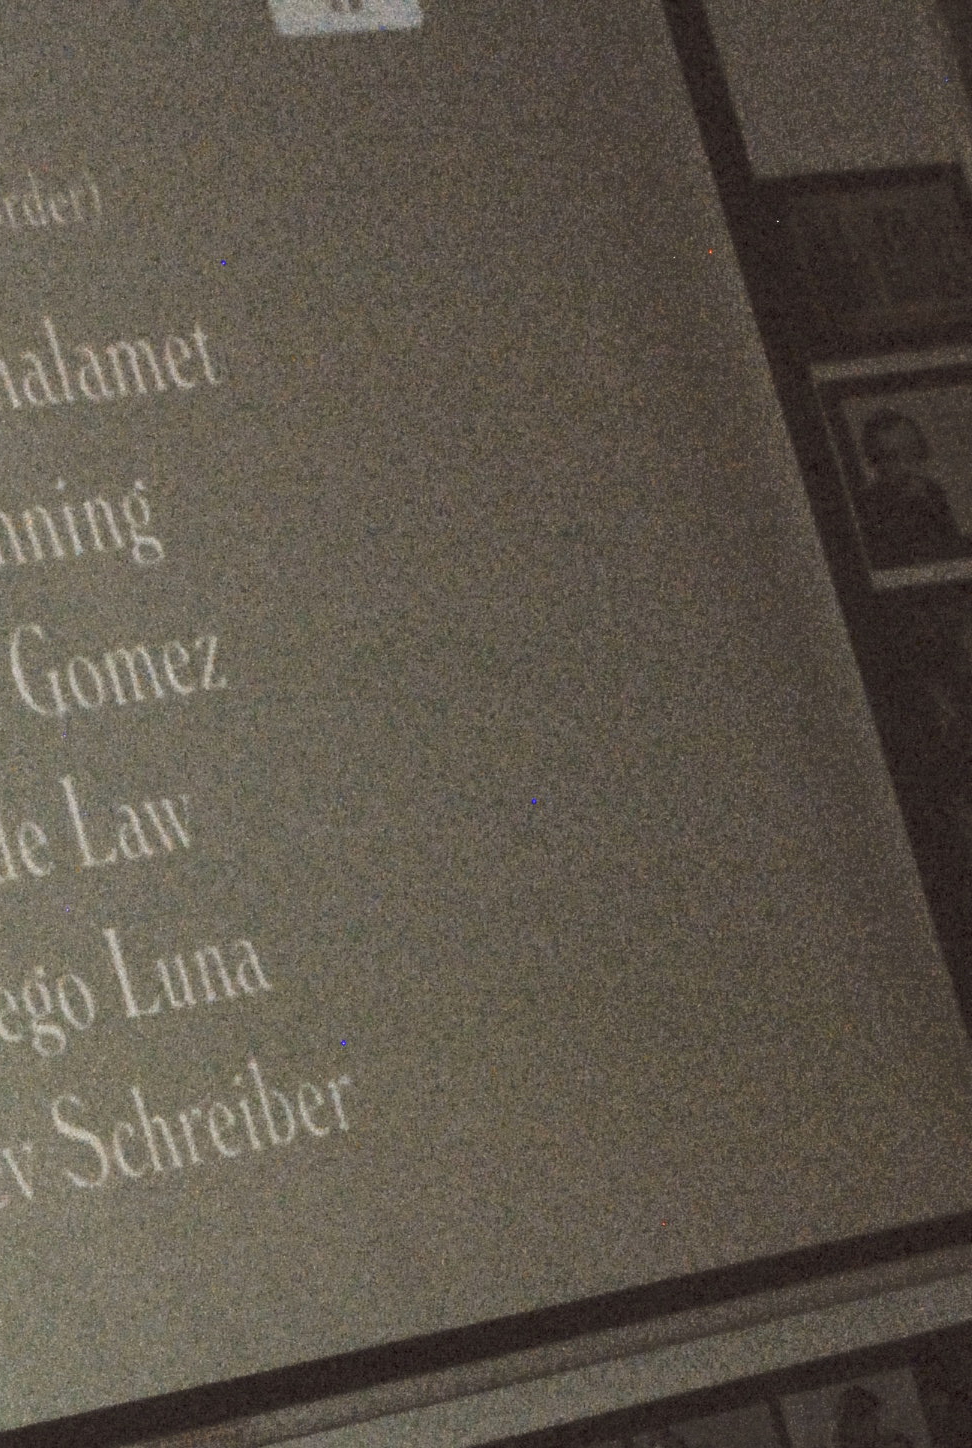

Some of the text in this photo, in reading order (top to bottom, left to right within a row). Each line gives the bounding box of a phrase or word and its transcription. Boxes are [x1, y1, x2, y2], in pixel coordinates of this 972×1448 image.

[9, 624, 227, 717] Gomez
[59, 773, 195, 870] Law
[103, 926, 275, 1020] Luna
[50, 1056, 354, 1190] Schreiber
